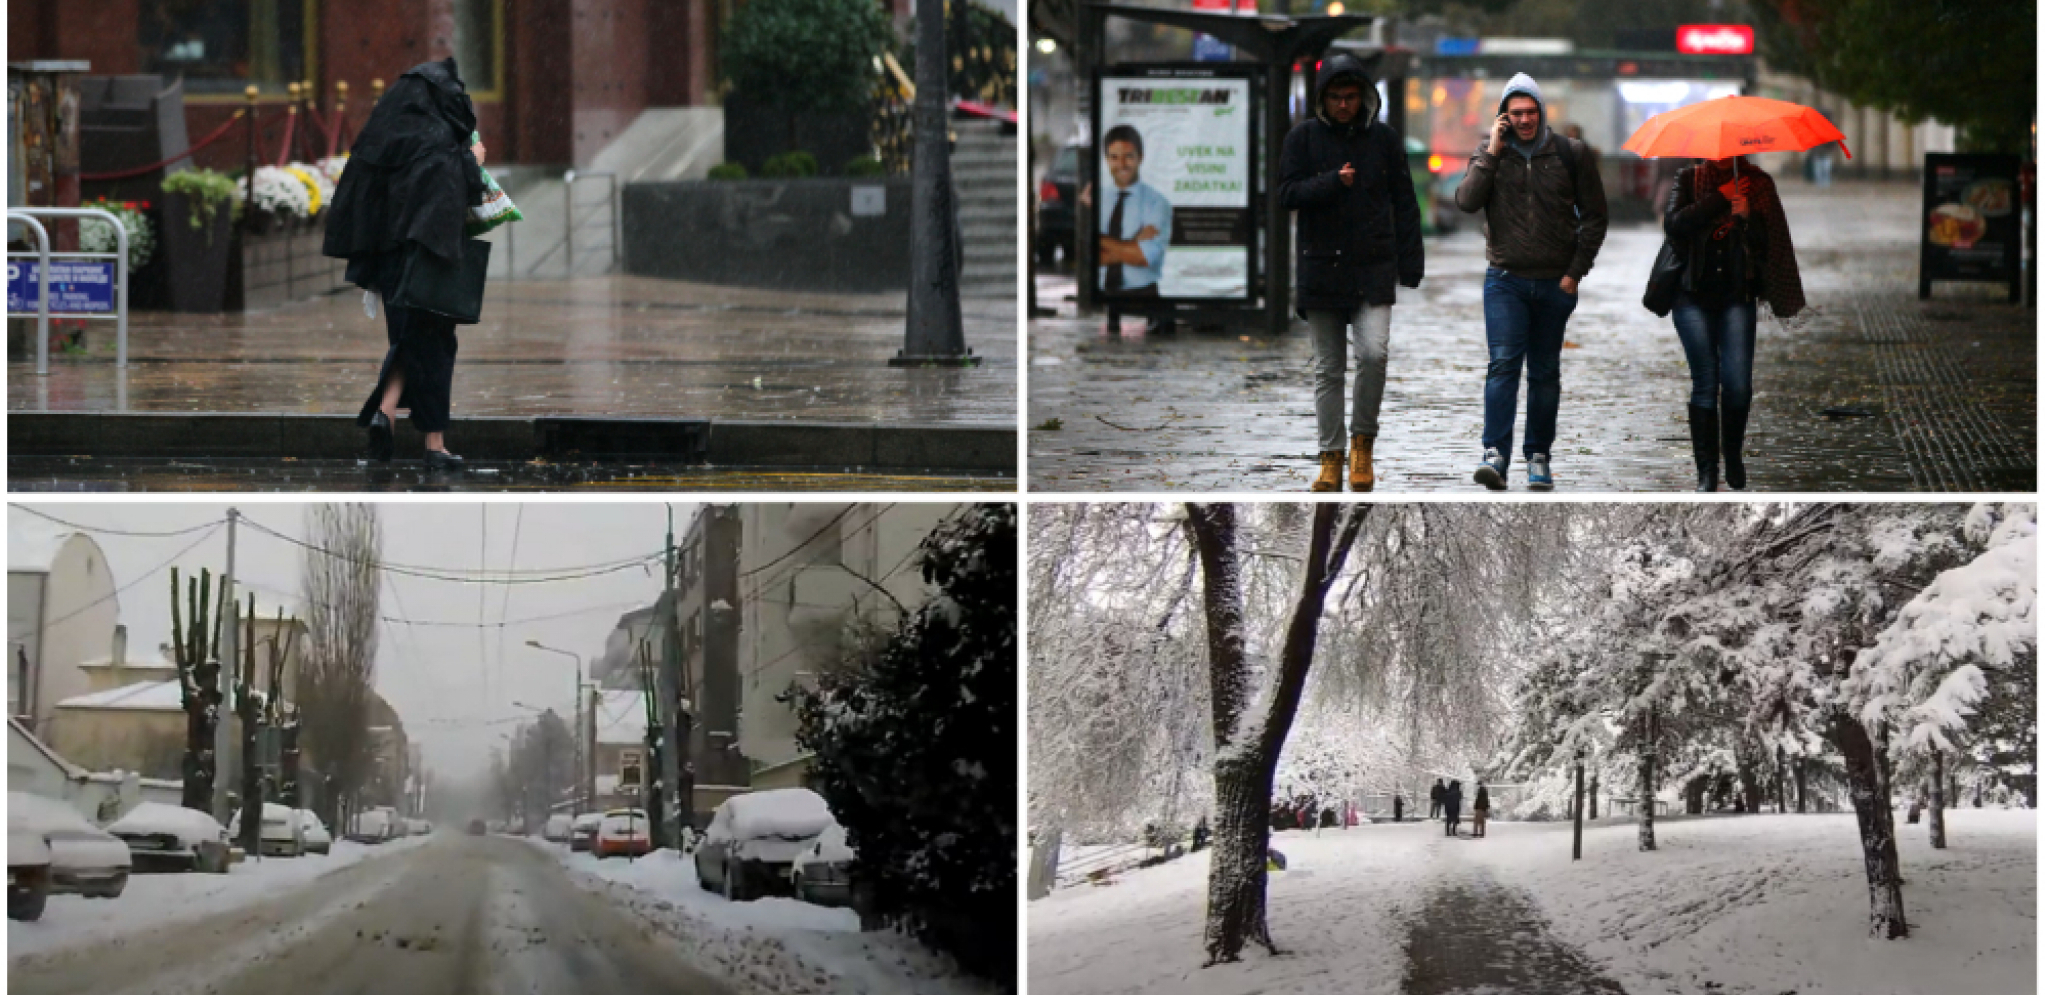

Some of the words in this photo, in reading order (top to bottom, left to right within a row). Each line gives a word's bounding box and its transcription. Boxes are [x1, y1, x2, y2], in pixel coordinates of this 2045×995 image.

[1118, 88, 1230, 105] TRIBESTAN
[1176, 146, 1212, 157] UVEK
[1215, 146, 1235, 157] NA
[1185, 163, 1226, 174] VISINI
[1173, 180, 1242, 192] ZADATKA!
